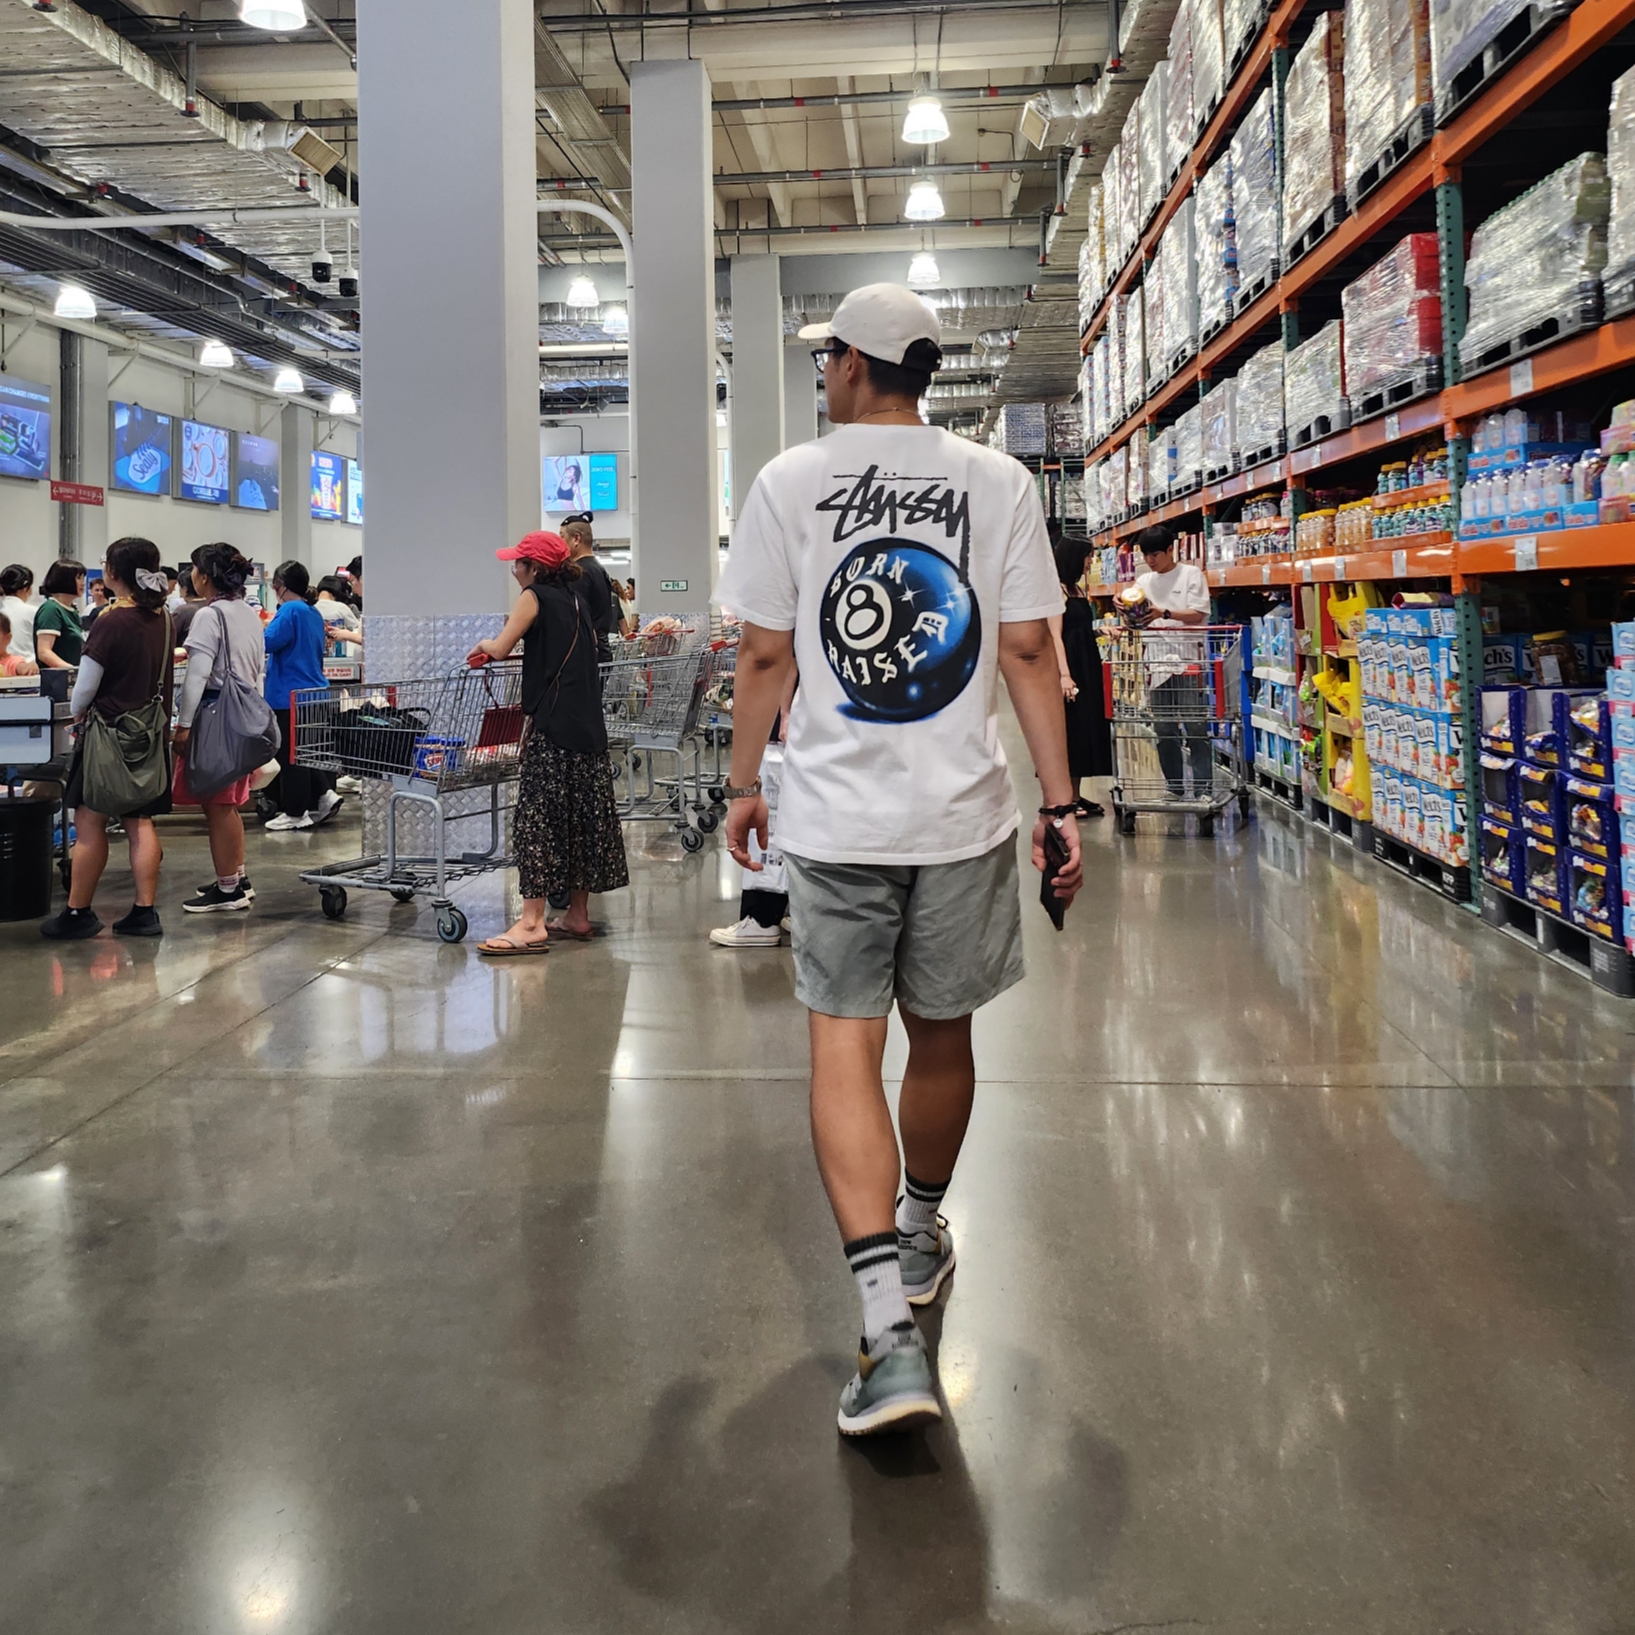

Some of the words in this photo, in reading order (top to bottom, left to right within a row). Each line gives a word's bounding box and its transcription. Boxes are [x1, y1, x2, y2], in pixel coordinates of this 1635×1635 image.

[132, 449, 159, 481] Sealy
[830, 553, 910, 598] BORN
[844, 583, 885, 641] 8
[827, 611, 949, 686] RAISED
[1484, 648, 1513, 665] ch's
